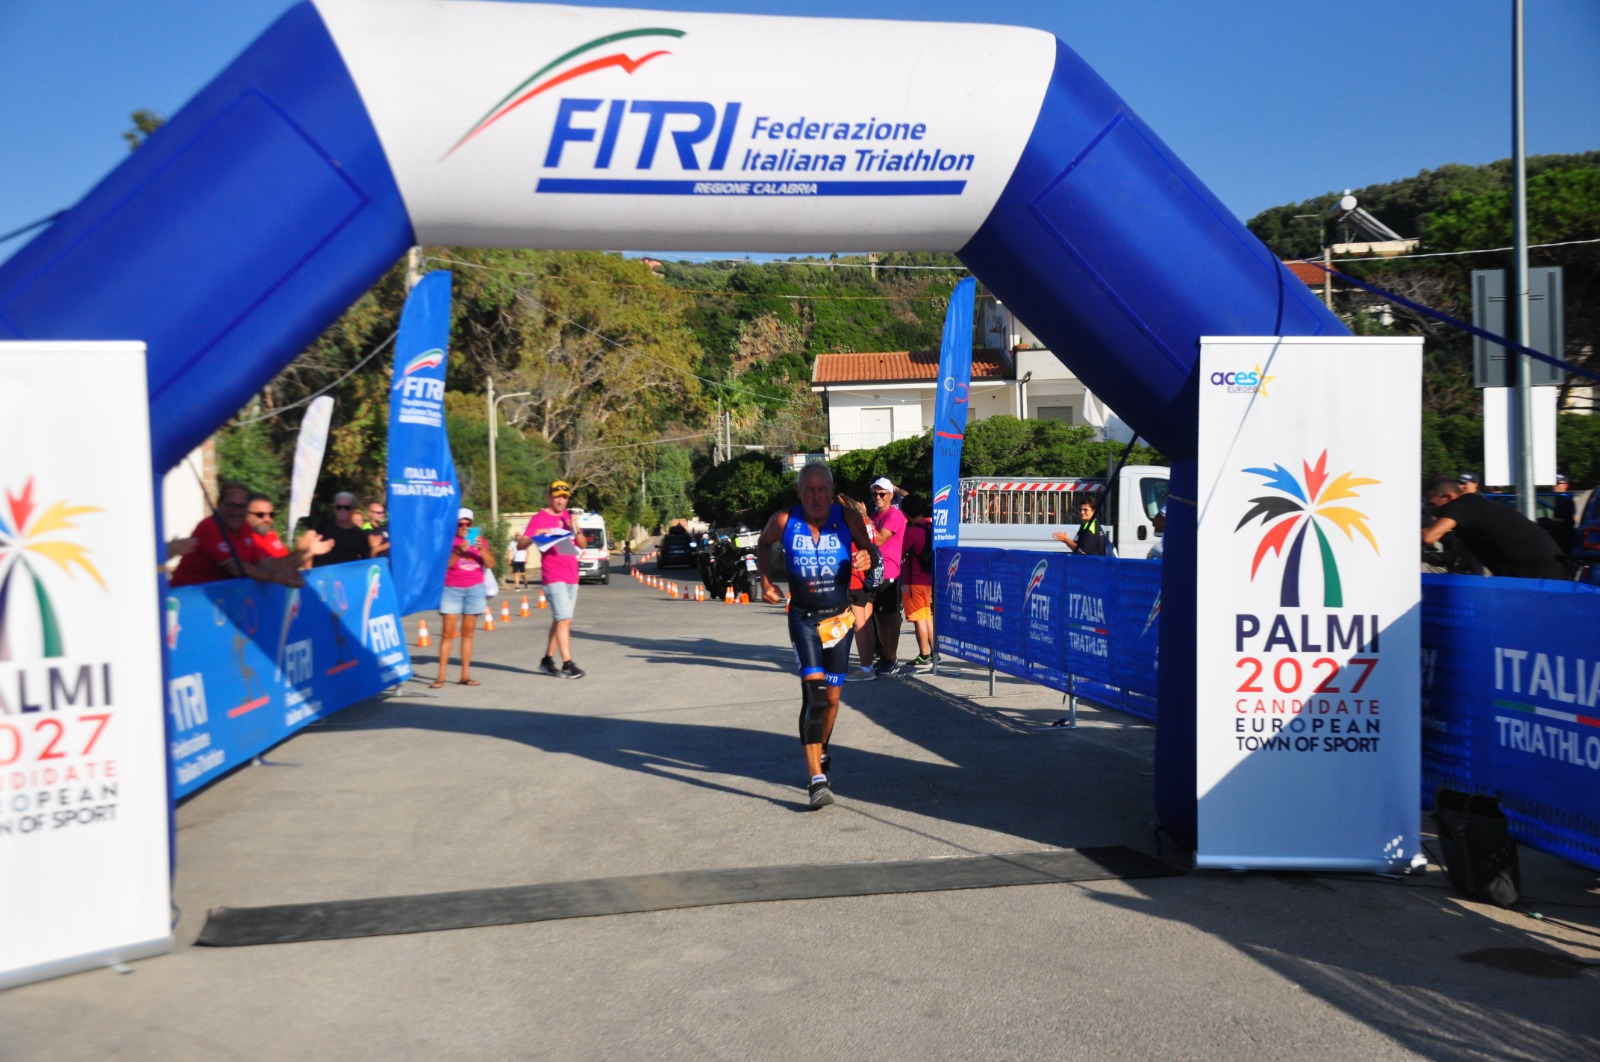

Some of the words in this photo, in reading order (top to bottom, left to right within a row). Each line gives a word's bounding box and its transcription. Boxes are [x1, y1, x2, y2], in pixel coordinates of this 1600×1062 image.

[543, 98, 742, 171] FITRI
[751, 117, 926, 141] Federazione
[741, 149, 847, 172] Italiana
[854, 149, 975, 173] Triathlon
[693, 182, 751, 195] REGIONE
[753, 182, 818, 195] CALABRIA
[1211, 372, 1258, 386] aces
[404, 467, 438, 480] ITALIA
[389, 483, 455, 498] TRIATHLON
[793, 556, 837, 566] ROCCO
[801, 565, 835, 577] ITA
[975, 579, 1003, 604] ITALIA
[1031, 593, 1050, 621] FITRI
[1069, 593, 1106, 625] ITALIA
[1068, 631, 1108, 658] TRIATHLON
[1236, 614, 1380, 653] PALMI
[1236, 657, 1380, 693] 2027
[1236, 699, 1380, 715] CANDIDATE
[1236, 718, 1381, 734] EUROPEAN
[1236, 736, 1291, 751] TOWN
[1295, 737, 1319, 752] OF
[1323, 737, 1381, 753] SPORT
[0, 760, 118, 792] DIDATE
[0, 782, 118, 814] OPEAN
[52, 803, 118, 830] SPORT
